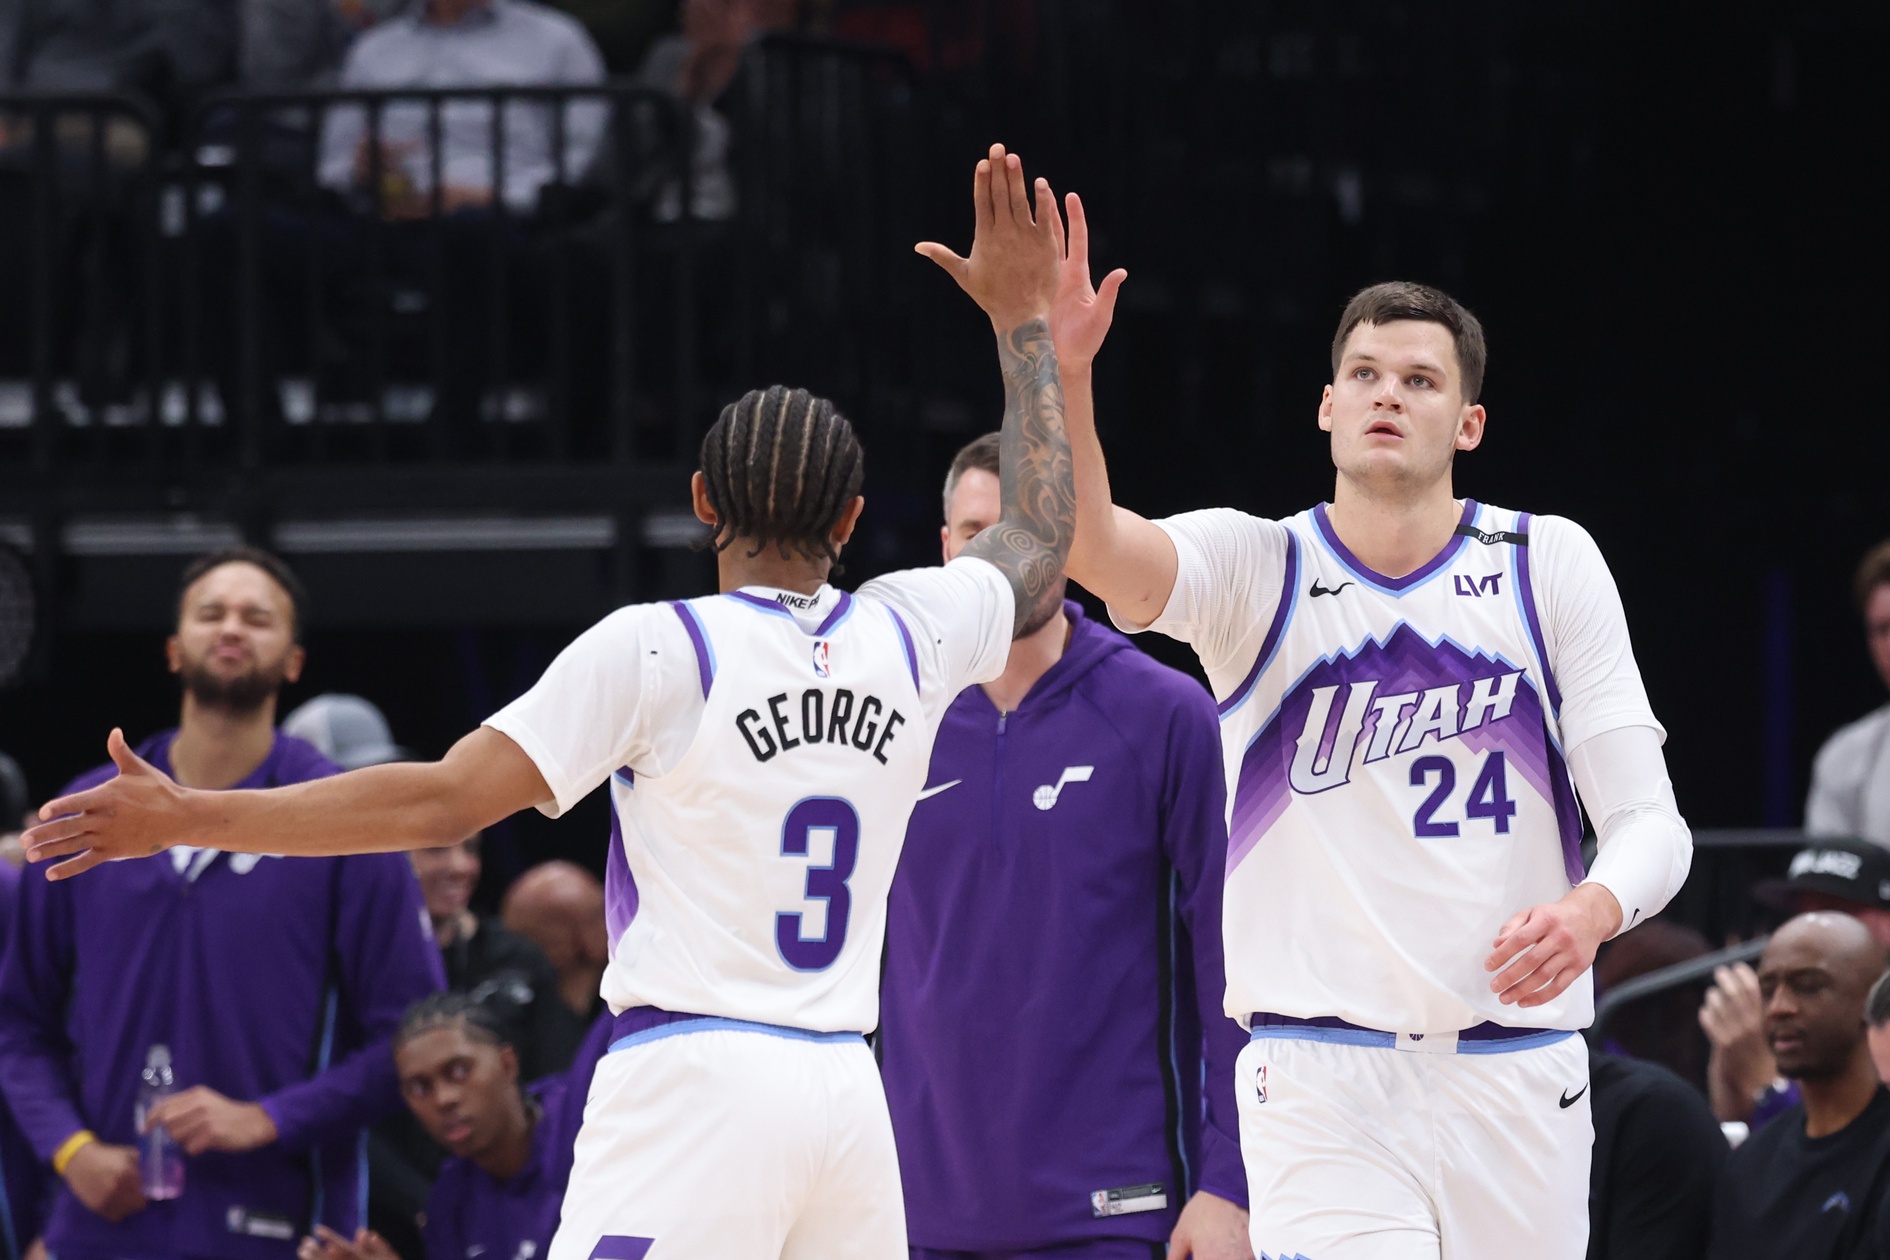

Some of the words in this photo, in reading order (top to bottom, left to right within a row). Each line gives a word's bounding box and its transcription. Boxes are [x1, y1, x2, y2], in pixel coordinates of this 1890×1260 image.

[1478, 531, 1505, 544] FRANK
[775, 593, 808, 609] NIKE
[1454, 572, 1503, 597] LVT
[735, 688, 906, 766] GEORGE
[1288, 667, 1527, 795] UTAH
[1408, 749, 1517, 839] 24
[774, 795, 861, 973] 3
